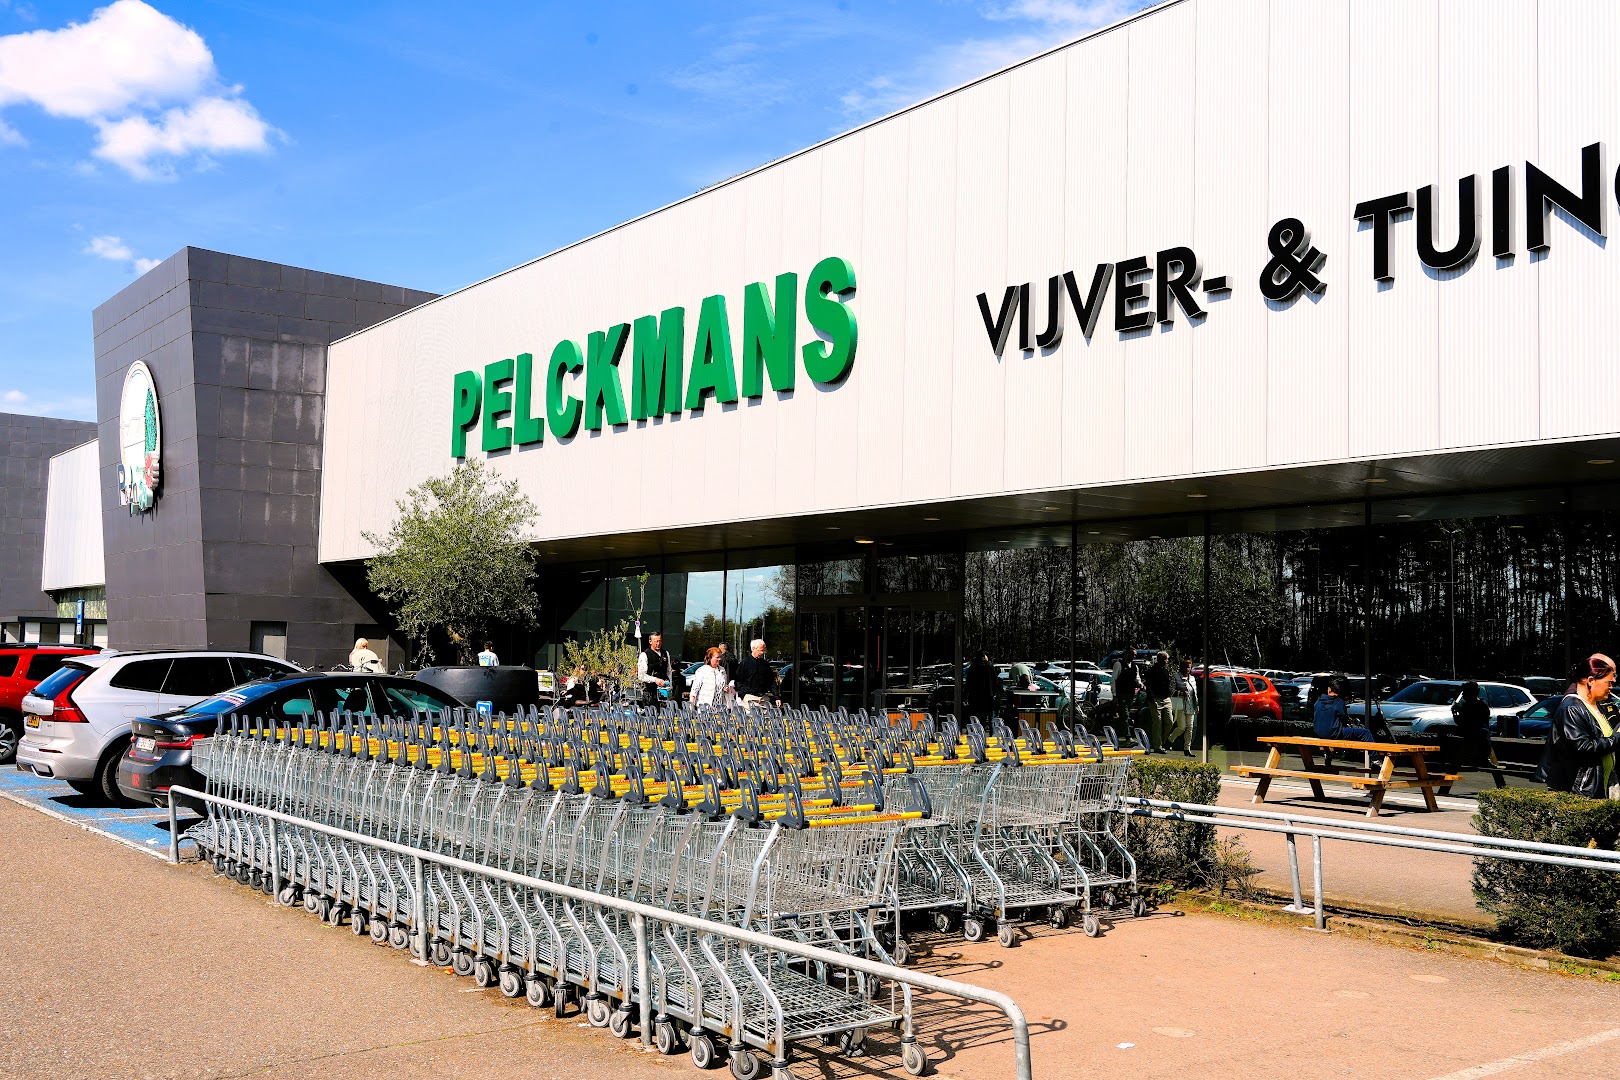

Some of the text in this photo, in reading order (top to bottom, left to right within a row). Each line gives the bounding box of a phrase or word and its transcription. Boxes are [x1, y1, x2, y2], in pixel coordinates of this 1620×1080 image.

[976, 141, 1620, 357] VIJVER- & TUIN
[451, 256, 858, 458] PELCKMANS
